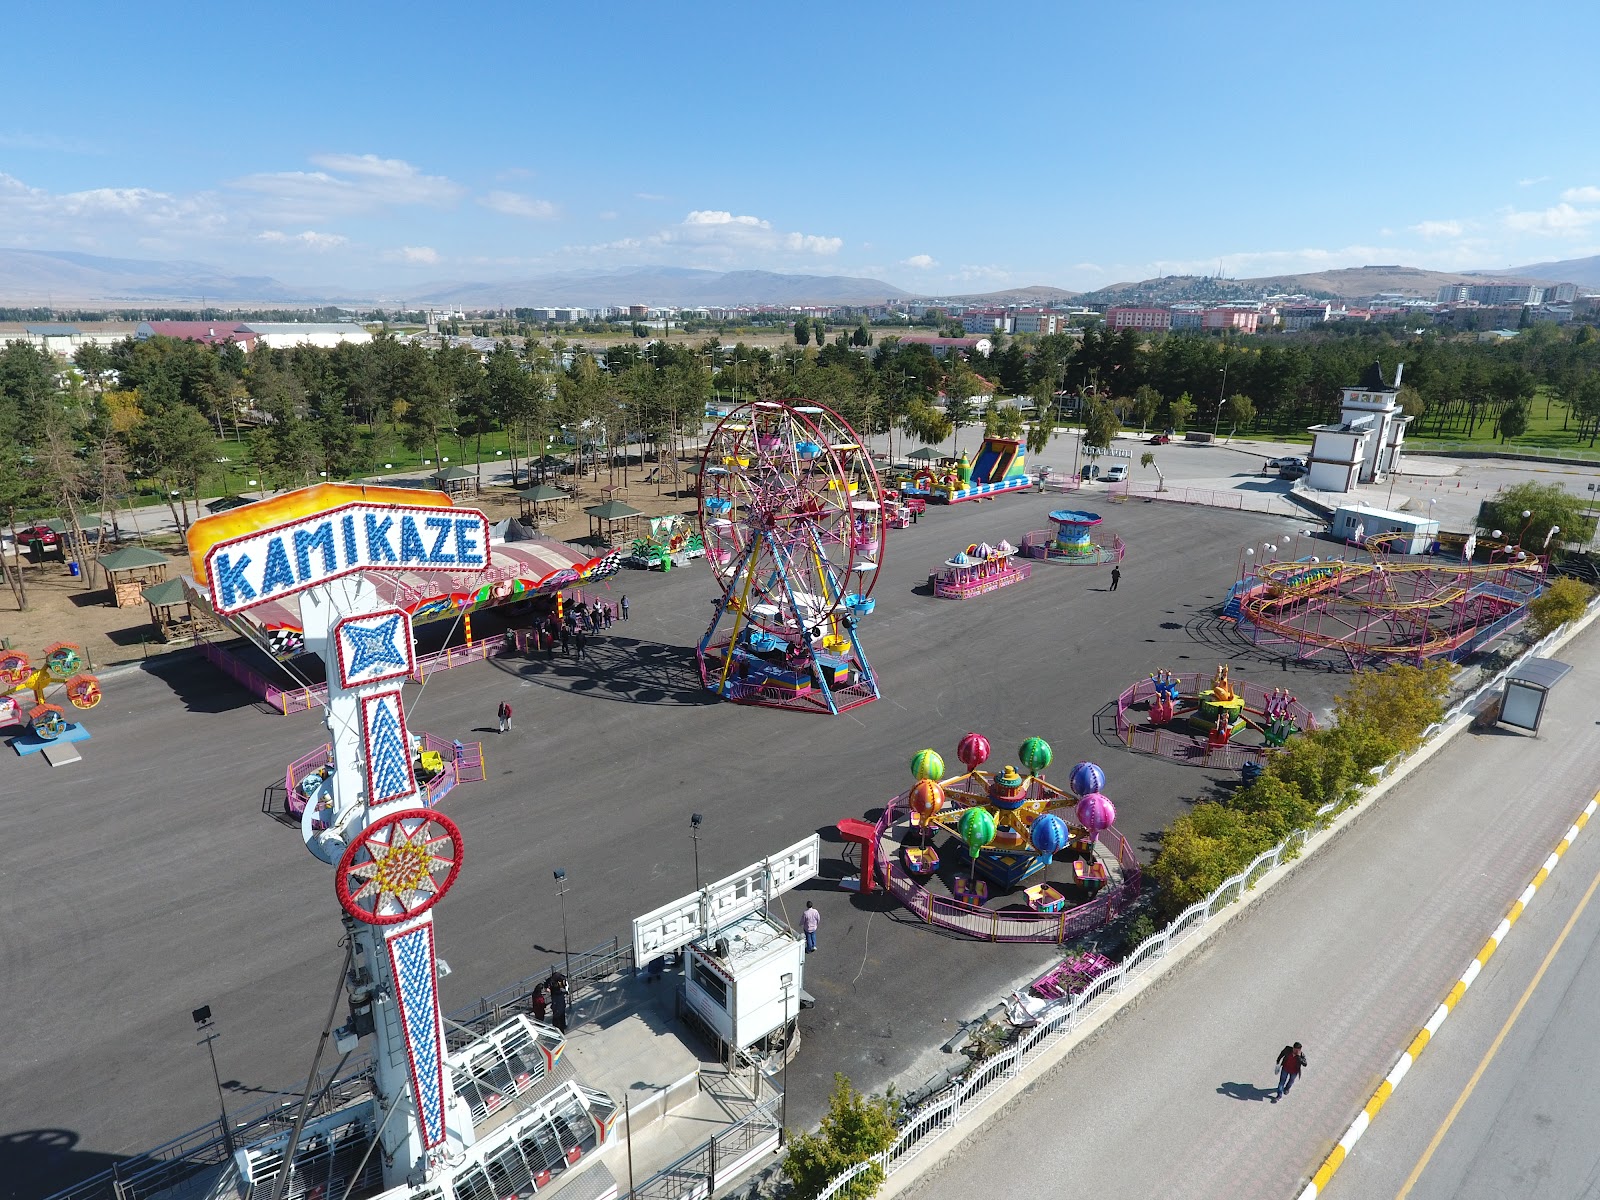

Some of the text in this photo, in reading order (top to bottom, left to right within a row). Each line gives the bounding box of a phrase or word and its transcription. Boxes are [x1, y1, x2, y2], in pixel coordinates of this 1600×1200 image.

[214, 513, 484, 607] KAMIKAZE
[391, 561, 530, 602] AUTO SCOOTER
